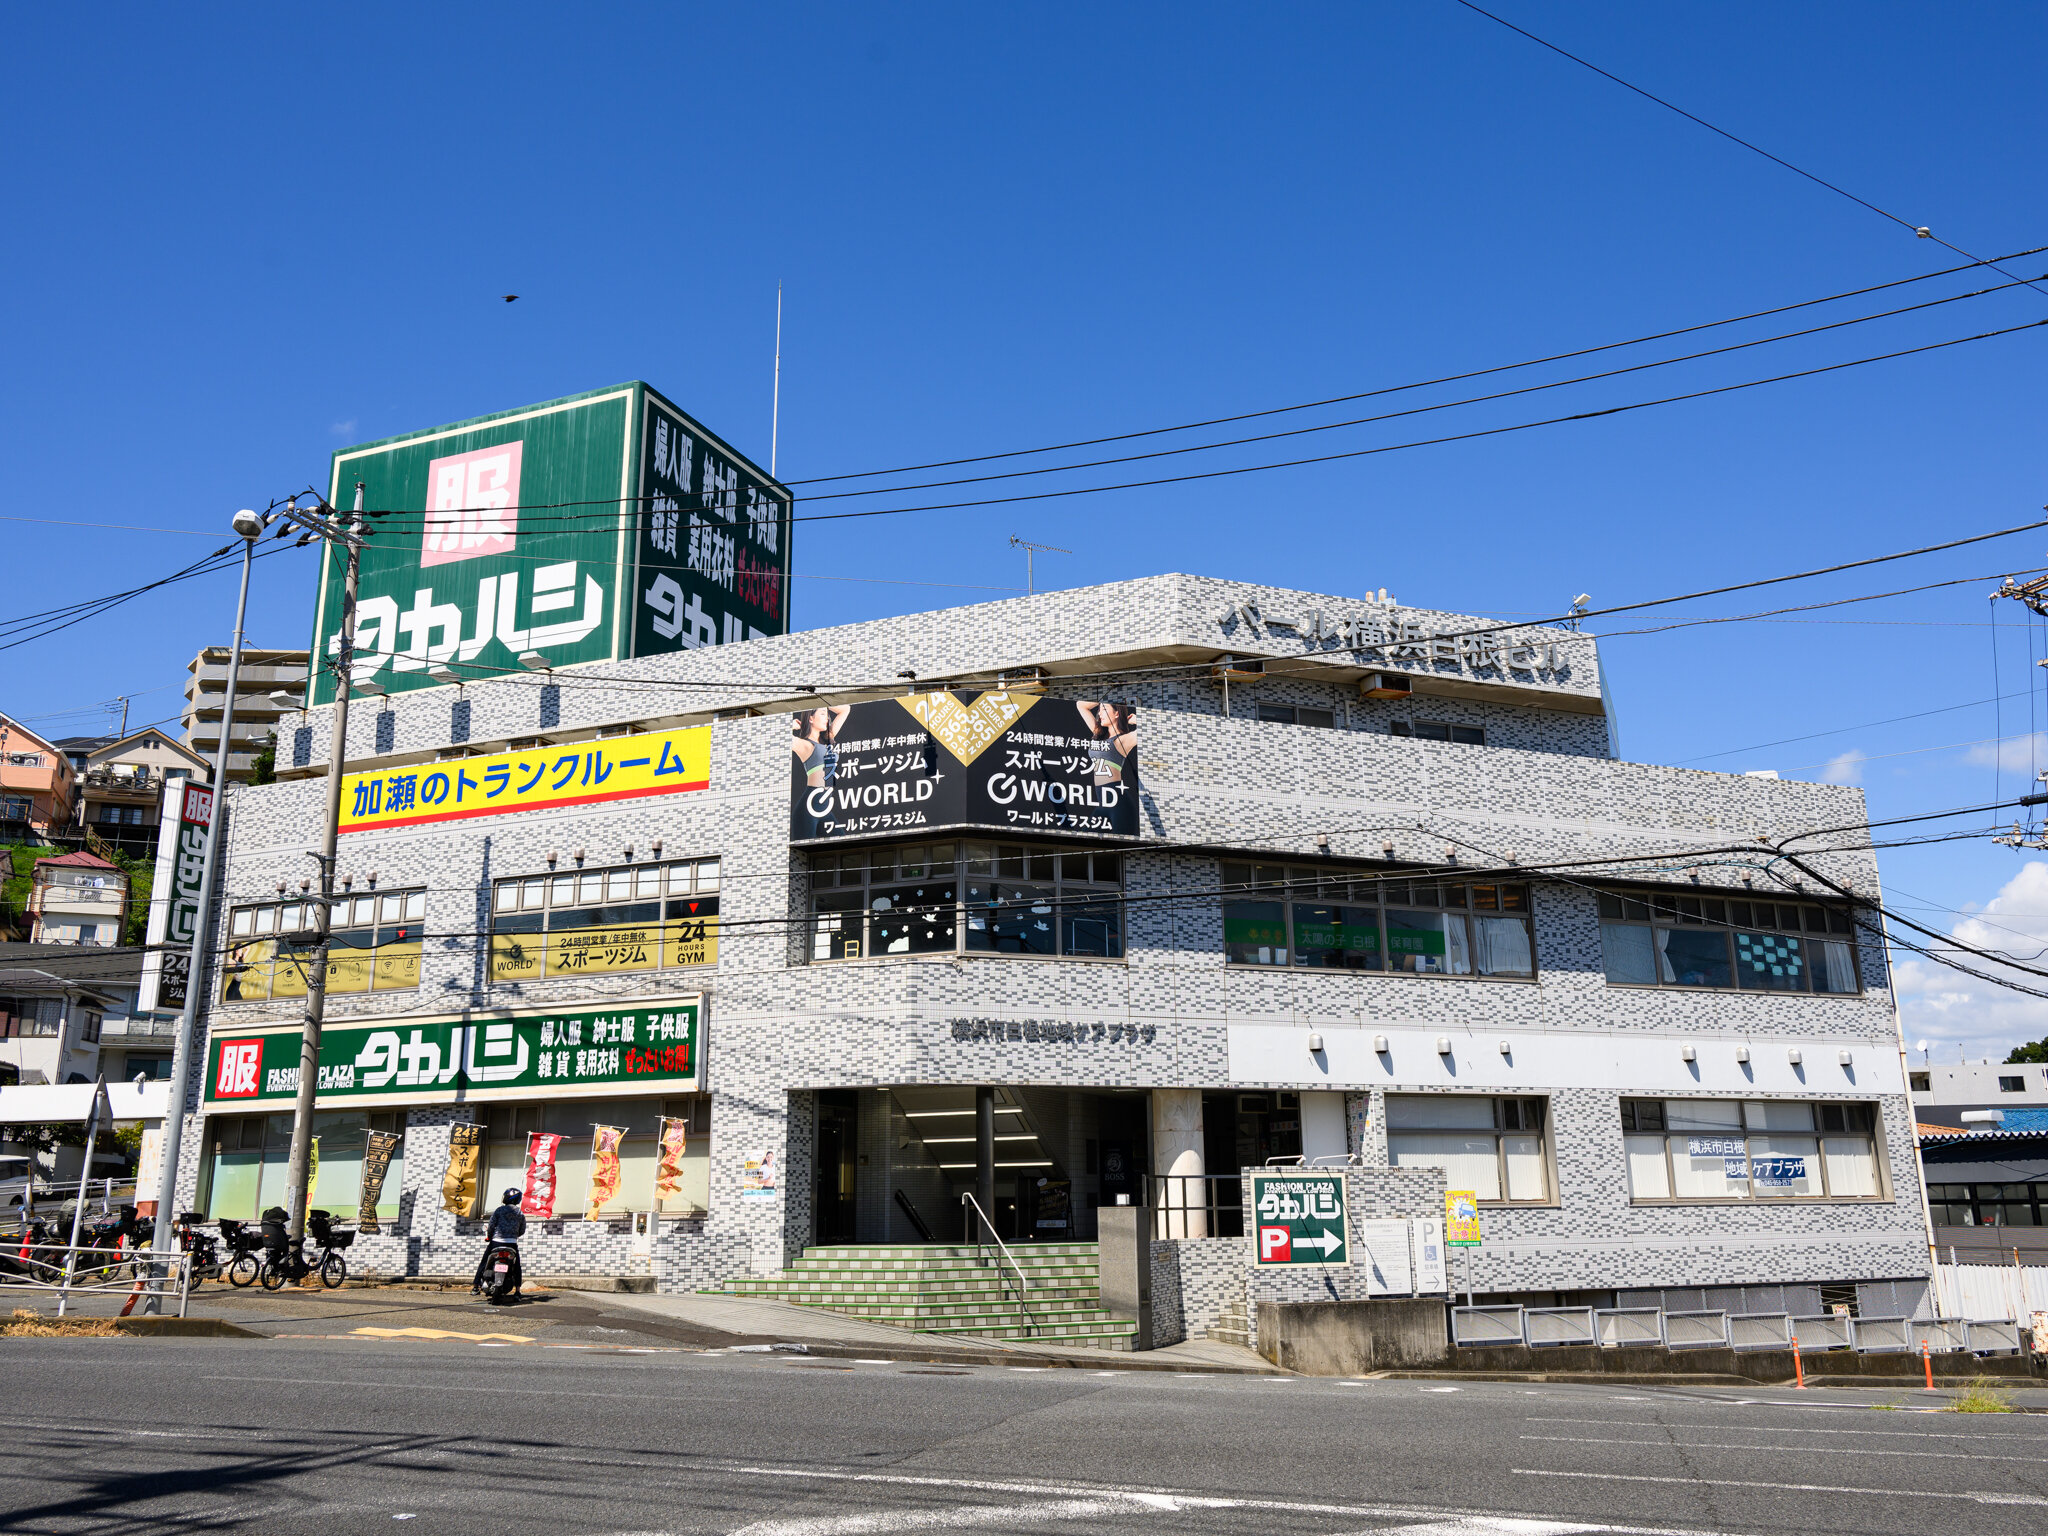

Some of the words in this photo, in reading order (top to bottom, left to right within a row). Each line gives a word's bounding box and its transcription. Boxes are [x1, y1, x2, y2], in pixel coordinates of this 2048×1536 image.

[654, 416, 692, 494] 婦人服
[702, 451, 737, 525] 紳士服
[746, 484, 778, 555] 子供服
[427, 452, 511, 553] 服
[651, 488, 679, 559] 雑貨
[688, 512, 735, 592] 実用衣料
[327, 560, 604, 681] タカハシ
[645, 572, 768, 650] タカハ
[1217, 599, 1570, 673] パール横浜白根ビル
[915, 691, 947, 722] 24
[929, 700, 955, 729] HOURS
[978, 699, 1006, 729] HOURS
[986, 691, 1020, 721] 24
[351, 741, 686, 817] 加瀬のトランクルーム
[823, 751, 929, 781] スポーツジム
[1004, 751, 1115, 778] スポーツジム
[185, 789, 213, 825] 服
[1007, 809, 1113, 831] ワールドプラスジム
[823, 810, 927, 834] ワールドプラスジム
[678, 919, 706, 943] 24
[558, 946, 648, 969] スポーツジム
[677, 944, 705, 952] HOURS
[677, 952, 705, 964] GYM
[163, 954, 189, 975] 24
[540, 1020, 582, 1047] 婦人服
[592, 1016, 635, 1044] 紳士服
[646, 1013, 690, 1041] 子供服
[217, 1045, 260, 1094] 服
[355, 1023, 529, 1088] タカハシ
[575, 1048, 620, 1077] 実用衣料
[625, 1043, 690, 1074] ぜったいお得!
[265, 1083, 299, 1092] EVERYDAY
[319, 1081, 335, 1090] LOW
[335, 1080, 355, 1089] PRICE
[317, 1064, 356, 1082] PLAZA
[454, 1127, 471, 1138] 24
[1689, 1139, 1746, 1155] 横浜市白根
[1104, 1173, 1125, 1181] BOSS
[1264, 1182, 1304, 1191] FASHION
[1305, 1182, 1335, 1191] PLAZA
[1257, 1194, 1341, 1220] タカハシ
[1261, 1228, 1289, 1259] P
[1423, 1222, 1435, 1243] P
